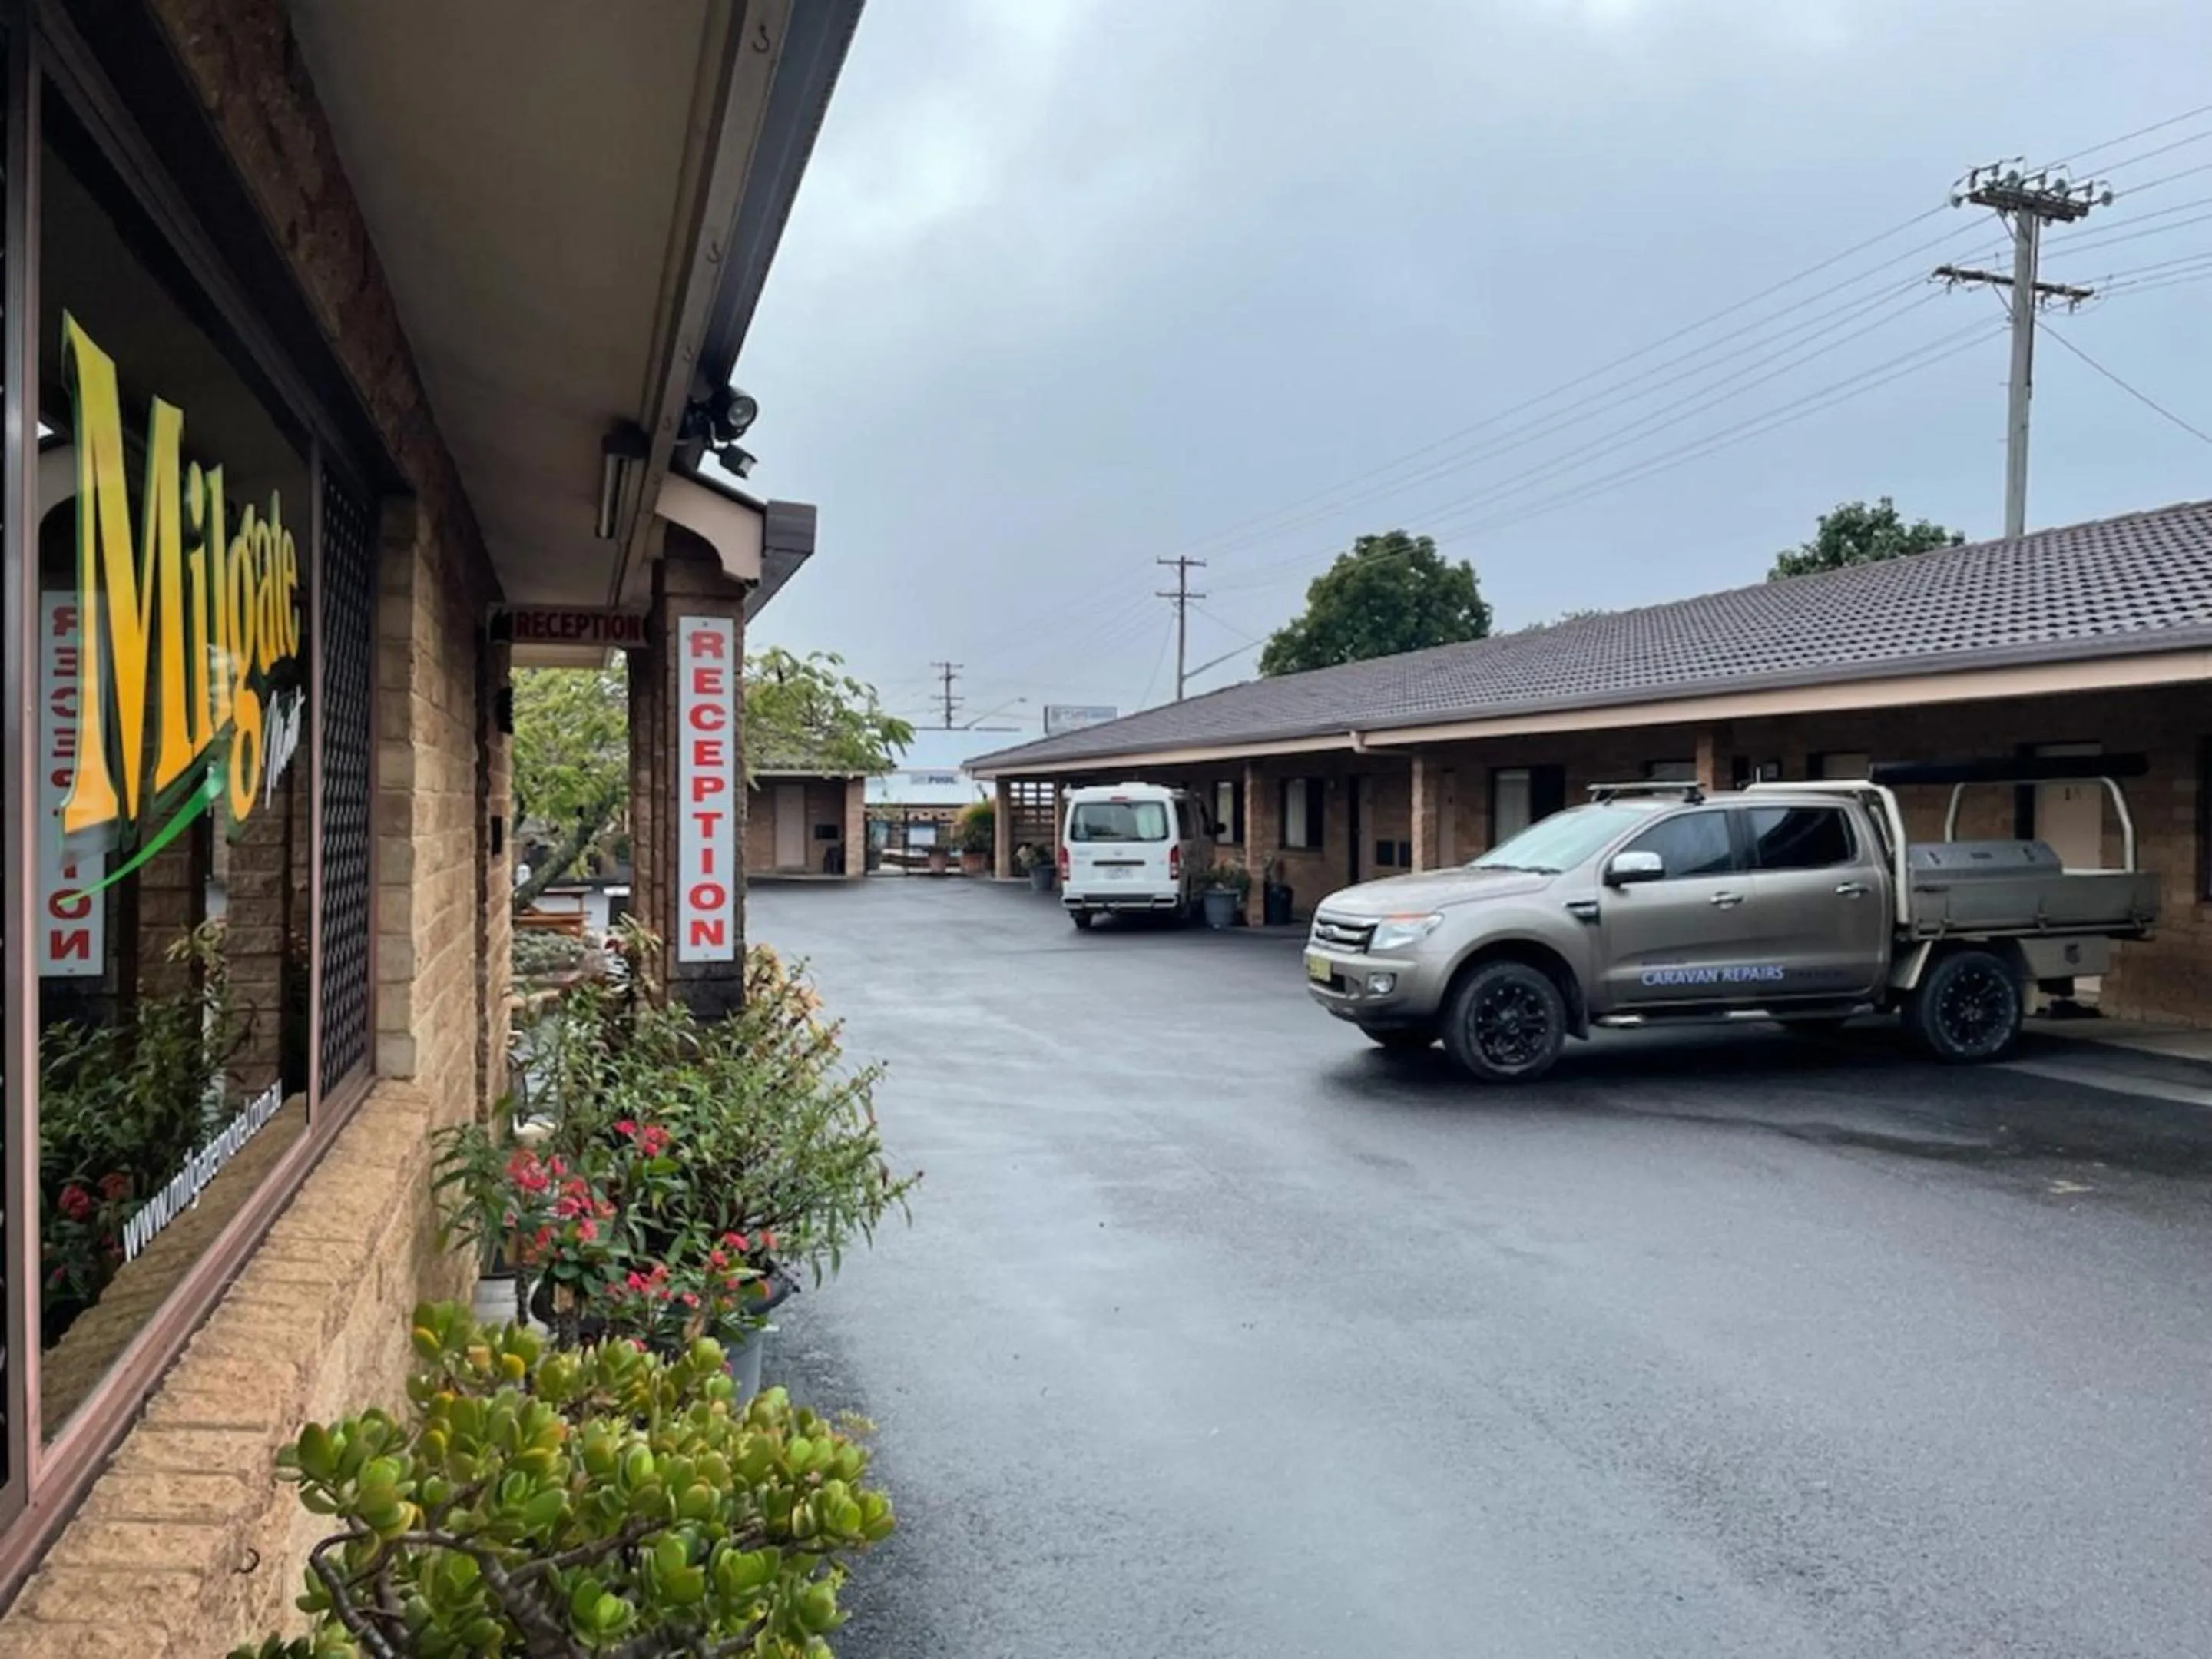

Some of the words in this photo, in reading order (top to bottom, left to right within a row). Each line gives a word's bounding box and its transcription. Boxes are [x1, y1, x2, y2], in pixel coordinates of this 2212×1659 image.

[65, 311, 300, 833] Milgate
[516, 611, 641, 641] RECEPTION
[688, 630, 727, 947] RECEPTION
[1641, 967, 1717, 986] CARAVAN
[1722, 965, 1784, 982] REPAIRS
